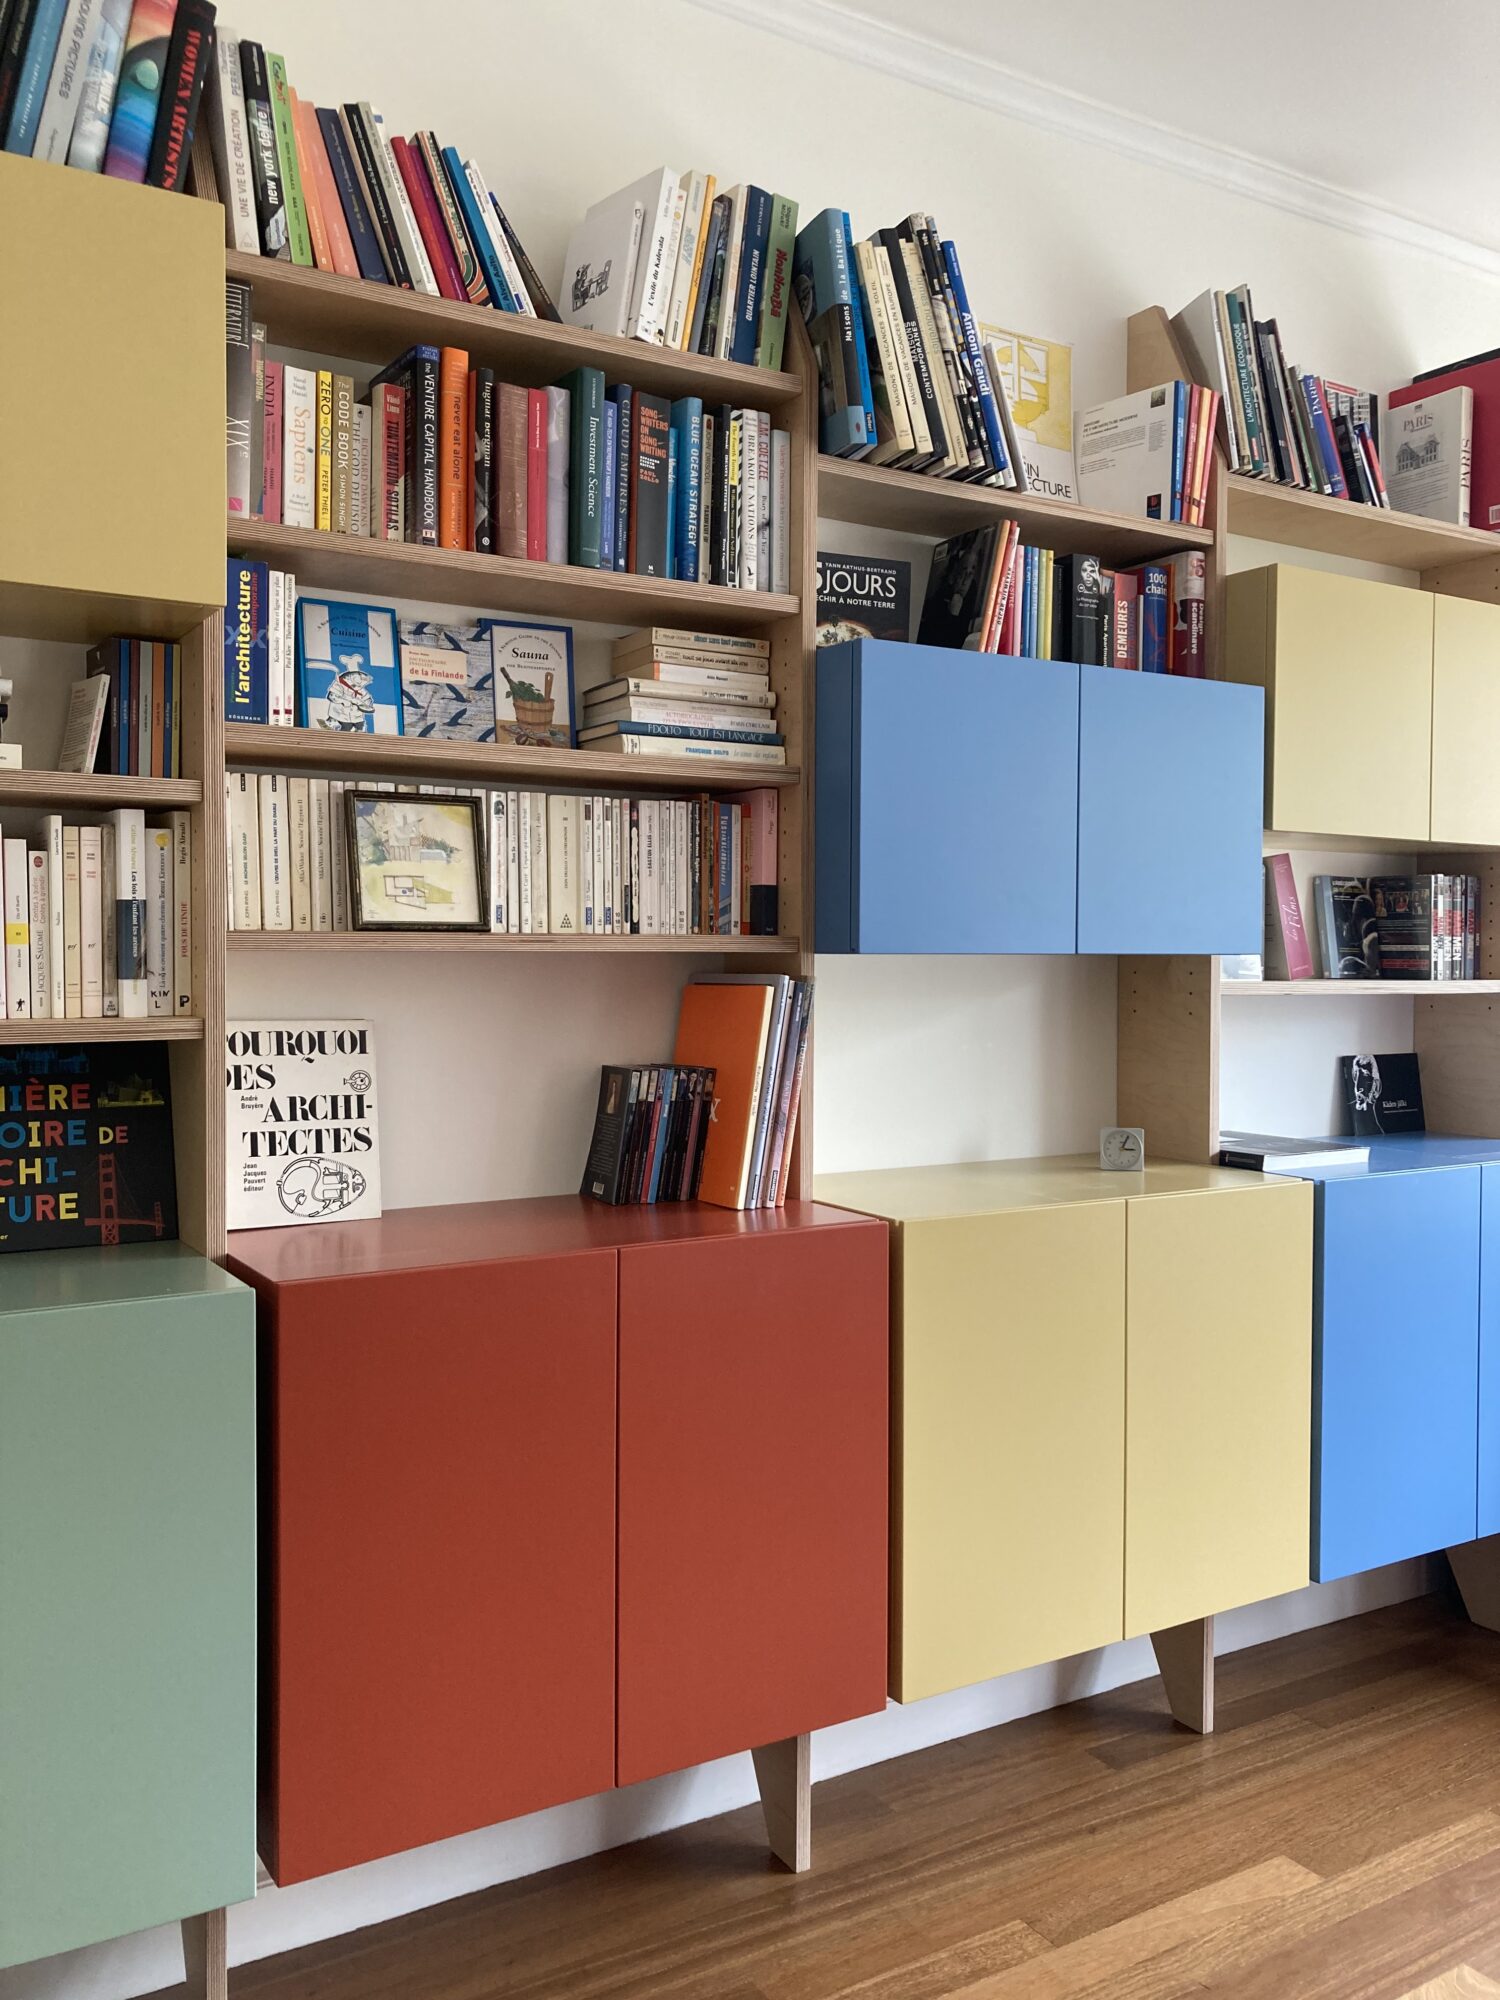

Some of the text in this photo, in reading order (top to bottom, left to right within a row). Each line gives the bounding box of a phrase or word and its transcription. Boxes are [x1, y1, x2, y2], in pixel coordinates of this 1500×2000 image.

[59, 39, 81, 100] PICTURES
[227, 43, 242, 96] PERRIAND
[161, 28, 201, 190] WOMEN ARTISTS
[230, 109, 250, 218] UNE VIE DE CRÉATION
[256, 111, 278, 205] new york délire
[448, 210, 465, 240] Guide
[653, 235, 665, 280] du Kalevala
[483, 253, 512, 302] Alvar Aalto
[745, 249, 761, 321] QUARTIER LOINTAIN
[835, 228, 853, 342] Maisons de la Baltique
[886, 283, 896, 307] EUROPE
[891, 307, 898, 318] EN
[871, 280, 901, 407] MAISONS DE VACANCES AU SOLEIL
[894, 319, 906, 359] VACANCES
[960, 310, 981, 356] Antoni
[911, 320, 933, 399] CONTEMPORAINES
[1232, 323, 1255, 423] L'ARCHITECTURE ÉCOLOGIQUE
[264, 375, 275, 417] INDIA
[424, 374, 435, 420] VENTURE
[481, 381, 493, 419] Ingmar
[906, 371, 917, 406] MAISONS
[1309, 378, 1323, 416] PARIS
[319, 380, 331, 456] ZERO ONE
[338, 391, 350, 428] CODE
[640, 417, 669, 432] WRITERS
[1403, 413, 1434, 432] PARIS
[288, 406, 311, 485] Sapiens
[351, 421, 361, 467] THE GOD
[424, 423, 435, 465] CAPITAL
[452, 395, 464, 480] never eat alone
[640, 426, 650, 435] ON
[337, 431, 349, 470] BOOK
[588, 416, 599, 518] Investment Science
[618, 399, 630, 515] CLOUD EMPIRES
[639, 444, 667, 459] WRITING
[758, 418, 769, 482] J.M. COETZEE
[1460, 438, 1472, 488] PARIS
[360, 438, 369, 528] RICHARD DAWKINS
[385, 420, 400, 532] TUNTEMATON SOTILAS
[639, 468, 656, 478] PAUL
[639, 474, 660, 484] ZOLLO
[687, 415, 700, 548] BLUE OCEAN STRATEGY
[747, 434, 756, 539] BREAKOUT NATIONS
[1027, 477, 1072, 499] CTURE
[321, 470, 329, 518] PETER THIEL
[422, 467, 435, 526] HANDBOOK
[338, 502, 346, 528] SINGH
[842, 564, 897, 575] ARTHUS-BERTRAND
[1148, 572, 1168, 584] 1000
[838, 595, 896, 610] À NOTRE TERRE
[996, 565, 1012, 625] OSCAR NIEMEYER
[235, 569, 251, 704] l'architecture
[285, 610, 293, 669] Paul Klee de
[330, 627, 367, 639] Cuisine
[1117, 600, 1128, 659] DEMEURES
[511, 647, 549, 661] Sauna
[409, 668, 465, 680] de la Finlande
[688, 727, 764, 743] TOUT EST LANGAGE
[35, 929, 47, 994] JACQUES SALOMÉ
[180, 927, 188, 958] FOUS DE
[1443, 935, 1451, 961] MEN
[1451, 935, 1462, 960] MEN
[1466, 934, 1474, 959] MEN
[150, 990, 170, 998] KIN
[155, 1000, 161, 1009] L
[225, 1029, 370, 1064] OURQUOI
[240, 1102, 265, 1111] Bruyère
[261, 1093, 373, 1123] ARCHI-
[98, 1125, 129, 1145] DE
[242, 1125, 373, 1158] TECTES
[242, 1162, 259, 1170] Jean
[242, 1169, 268, 1178] Jacques
[243, 1177, 266, 1185] Pauvert
[0, 1192, 79, 1223] URE
